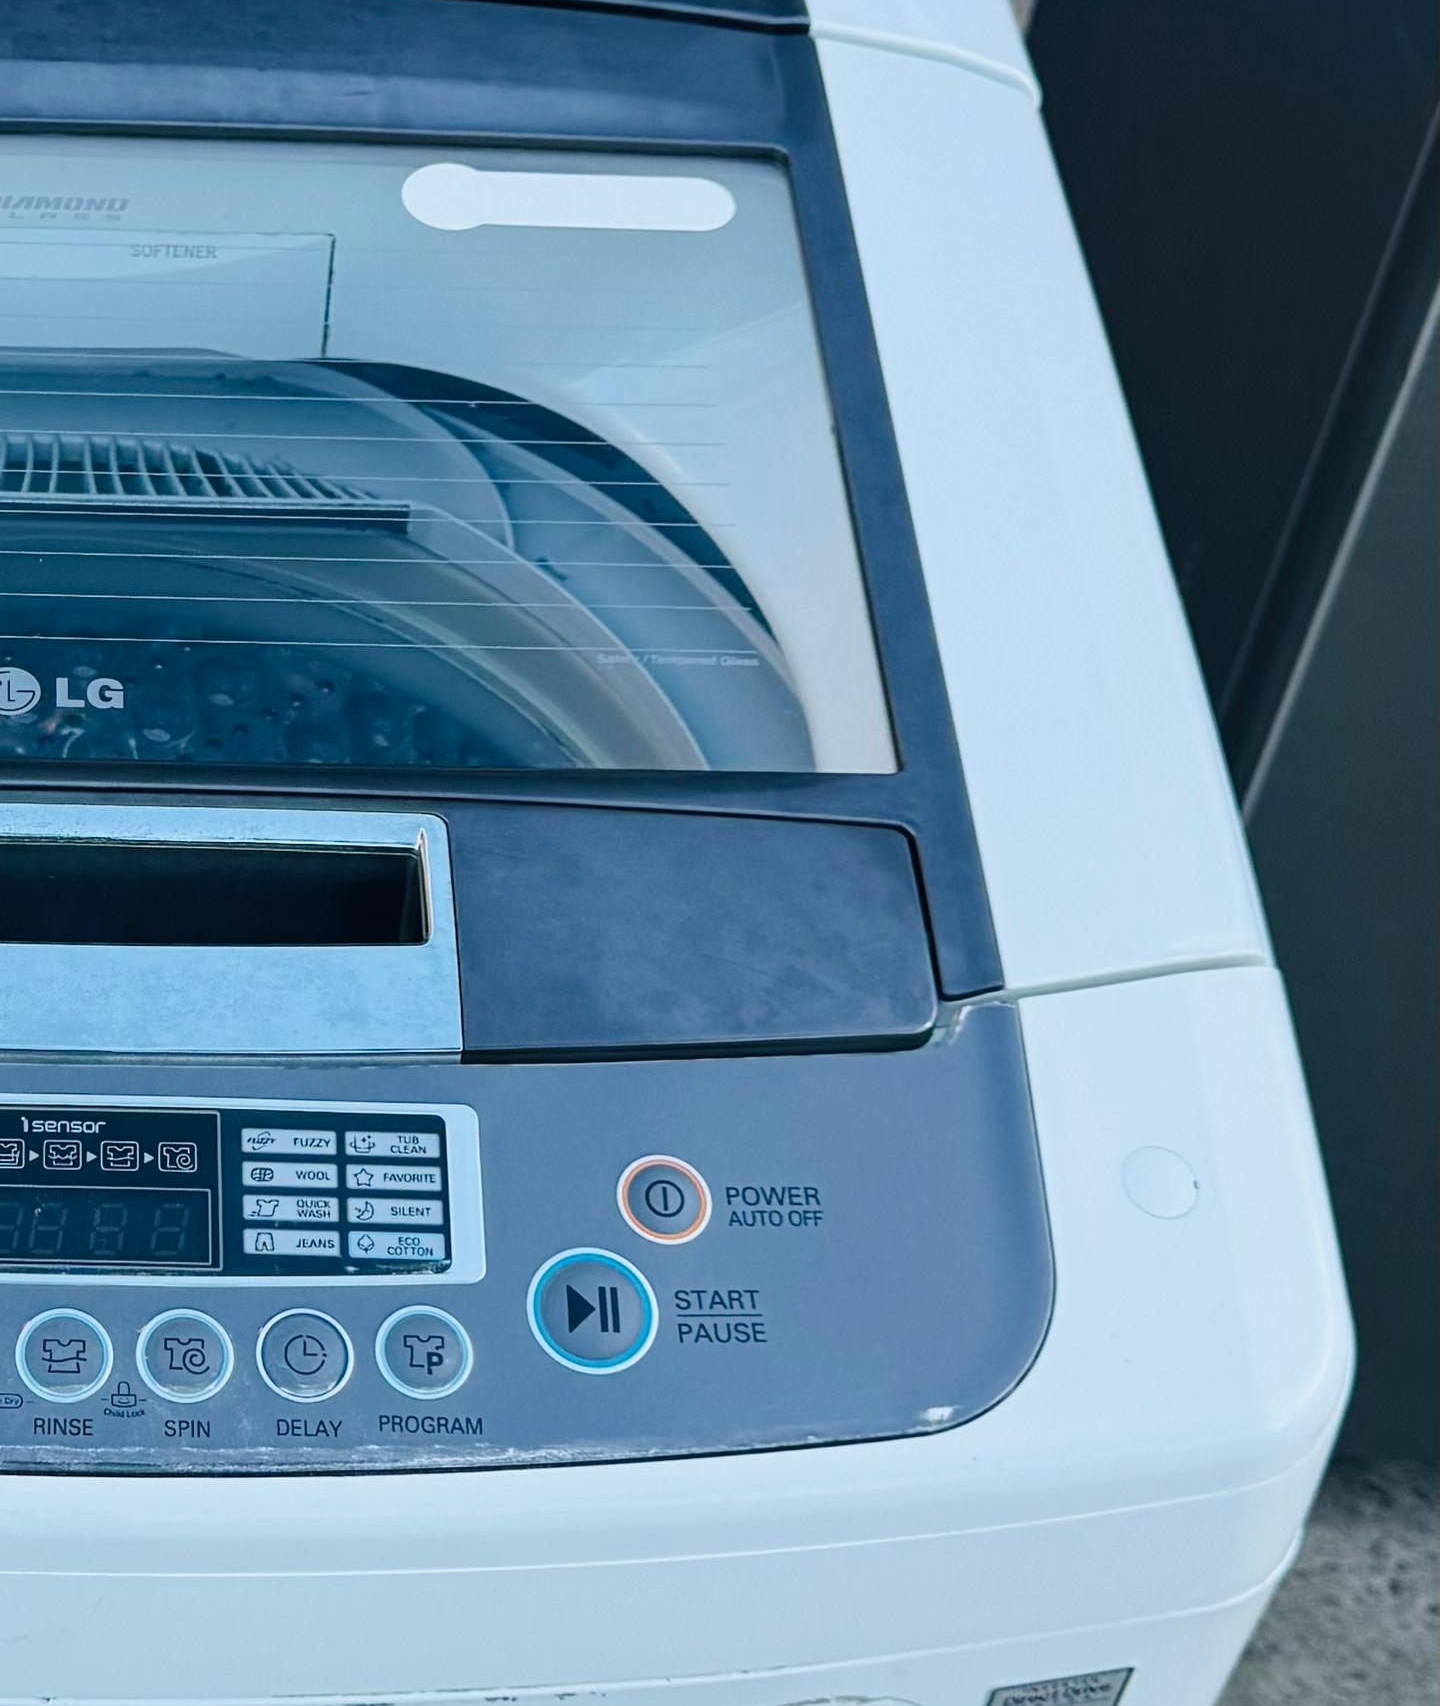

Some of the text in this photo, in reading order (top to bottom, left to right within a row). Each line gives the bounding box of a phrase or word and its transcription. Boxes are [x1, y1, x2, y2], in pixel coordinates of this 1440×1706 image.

[129, 243, 218, 260] SOFTENER
[55, 677, 125, 710] LG
[293, 1137, 331, 1149] FUZZY
[396, 1135, 420, 1145] TUB
[389, 1144, 427, 1155] CLEAN
[295, 1170, 331, 1182] WOOL
[383, 1172, 437, 1184] FAVORITE
[724, 1185, 821, 1207] POWER
[296, 1199, 331, 1209] QUICK
[296, 1209, 331, 1219] WASH
[390, 1206, 432, 1217] SILENT
[728, 1210, 825, 1228] AUTO OFF
[295, 1238, 336, 1250] JEANS
[397, 1236, 421, 1247] ECO
[387, 1246, 434, 1257] COTTON
[674, 1289, 761, 1311] START
[677, 1322, 769, 1345] PAUSE
[33, 1417, 95, 1437] RINSE
[163, 1419, 212, 1439] SPIN
[275, 1418, 344, 1439] DELAY
[378, 1414, 485, 1436] PROGRAM
